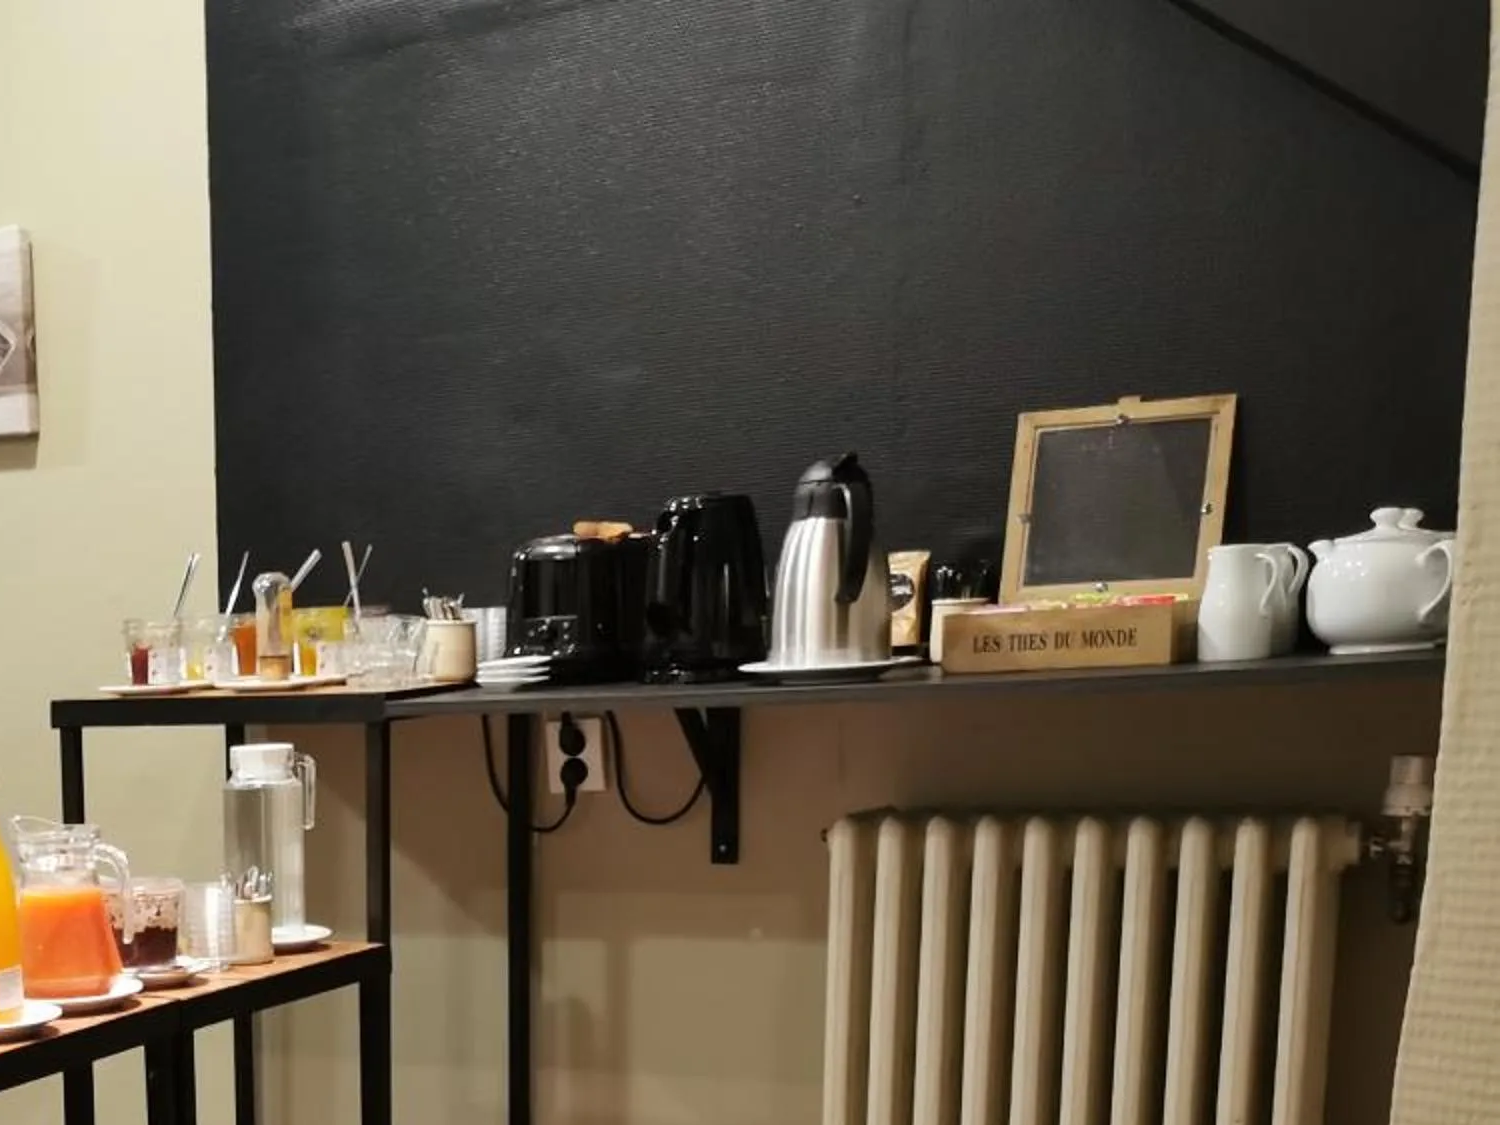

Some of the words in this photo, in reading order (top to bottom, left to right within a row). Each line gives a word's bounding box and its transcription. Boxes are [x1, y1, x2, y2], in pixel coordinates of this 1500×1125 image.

[973, 634, 1001, 653] LES
[1008, 632, 1048, 652] THES
[1054, 630, 1074, 650] DU
[1081, 627, 1138, 649] MONDE
